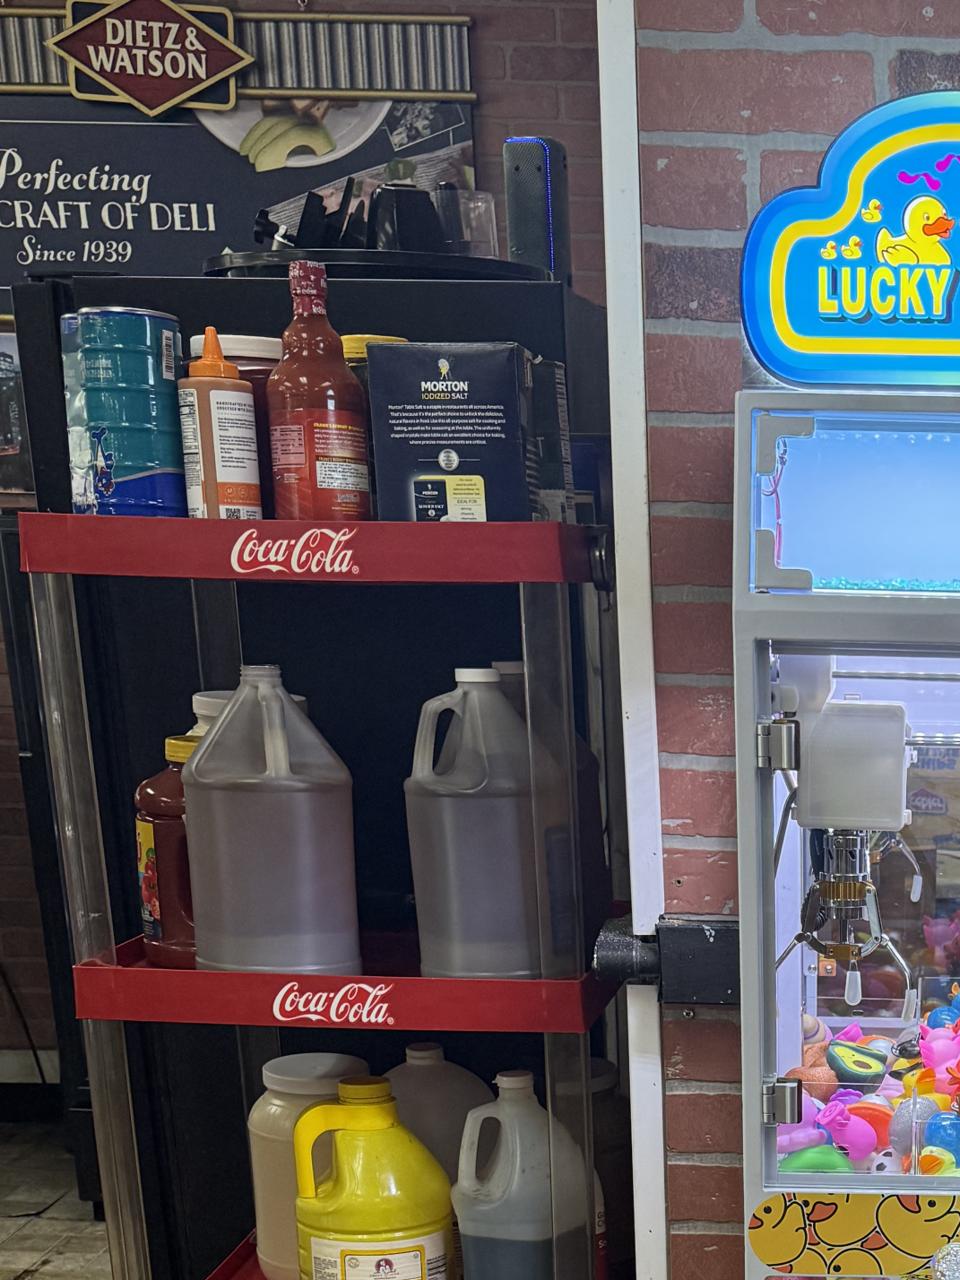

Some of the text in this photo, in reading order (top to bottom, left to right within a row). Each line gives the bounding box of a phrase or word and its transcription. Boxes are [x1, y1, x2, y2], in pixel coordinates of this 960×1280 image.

[105, 18, 207, 52] DIETZ &
[87, 45, 207, 81] WATSON
[0, 148, 151, 204] Perfecting
[0, 200, 216, 232] CRAFT OF DELI
[16, 234, 133, 266] Since 1939
[818, 267, 952, 316] LUCKY
[421, 381, 468, 391] MORTON
